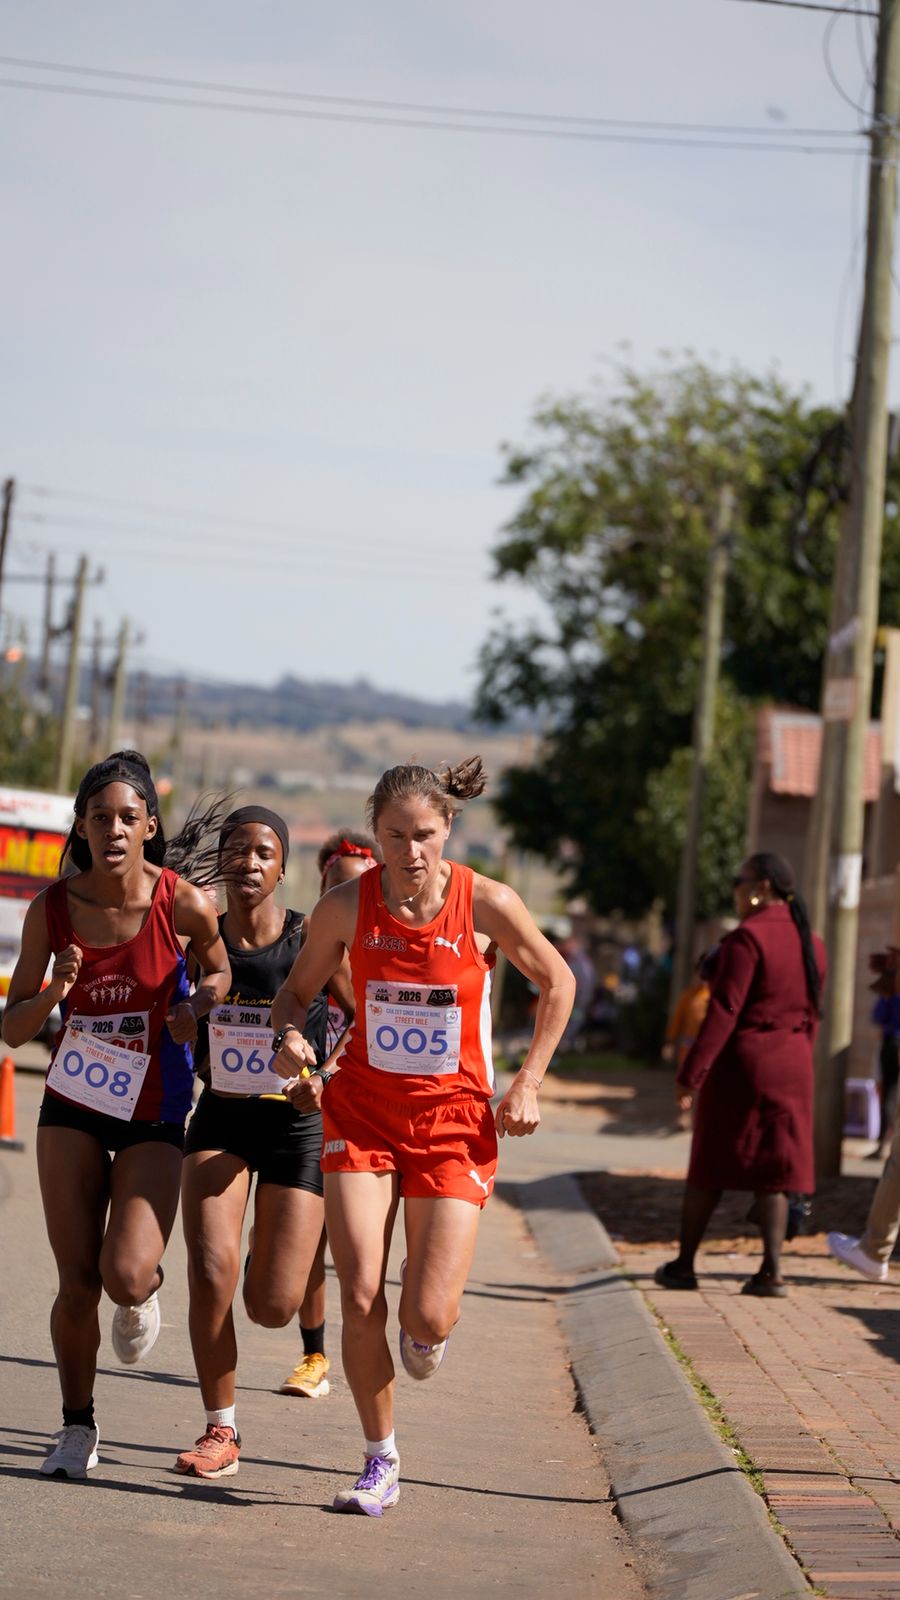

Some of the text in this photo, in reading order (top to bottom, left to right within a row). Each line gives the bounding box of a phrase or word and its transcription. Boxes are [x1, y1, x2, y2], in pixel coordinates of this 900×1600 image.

[363, 933, 407, 952] BOXER
[126, 976, 138, 988] CLUB
[398, 991, 422, 1002] 2026
[430, 992, 452, 1000] ASA
[122, 1018, 142, 1027] ASA
[240, 1012, 261, 1024] 2026
[92, 1021, 114, 1033] 2026
[376, 1025, 448, 1056] 005
[85, 1046, 117, 1064] STREET MILE
[63, 1050, 132, 1097] 008
[322, 1139, 346, 1158] XER
